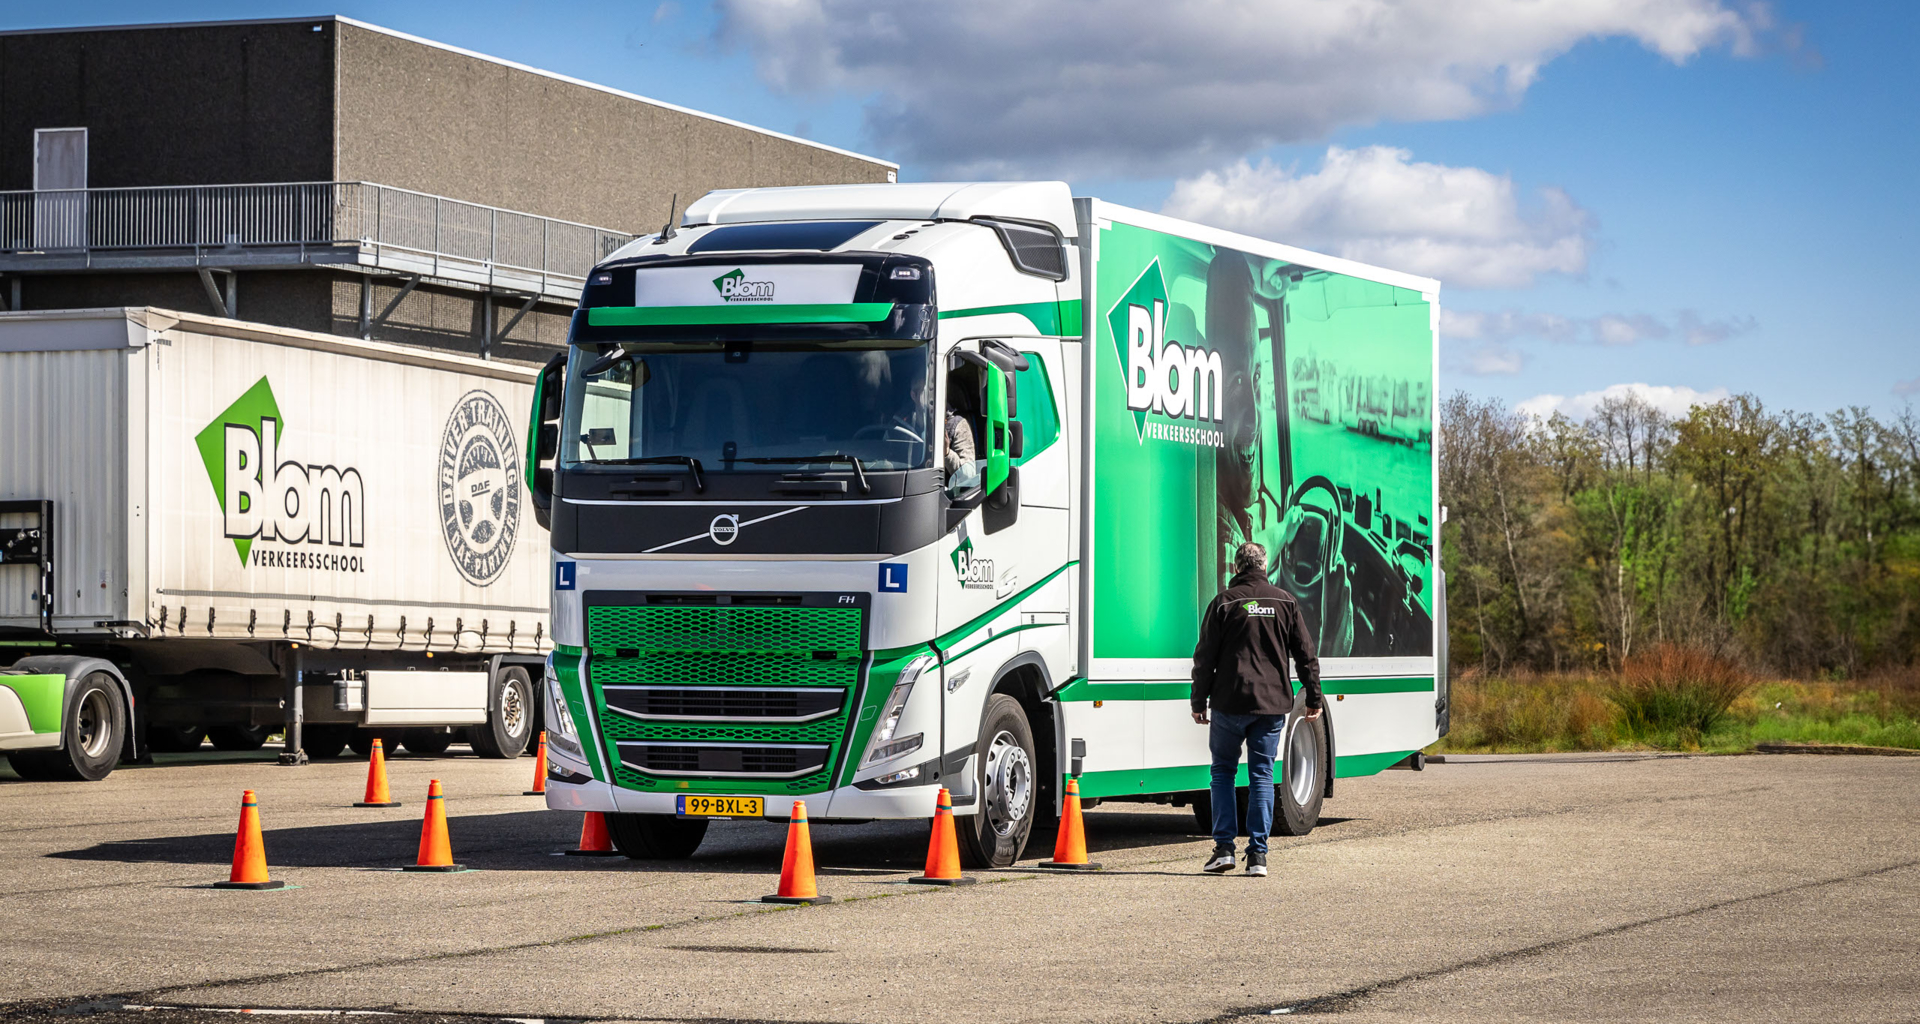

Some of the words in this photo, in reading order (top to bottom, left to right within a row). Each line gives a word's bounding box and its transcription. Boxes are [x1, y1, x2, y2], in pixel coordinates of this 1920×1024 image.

[720, 275, 775, 297] Blom
[1127, 298, 1224, 425] Blom
[1146, 422, 1225, 448] VERKEERSSCHOOL
[443, 412, 469, 506] DRIVER
[469, 400, 518, 486] TRAINING
[224, 415, 364, 548] Blom
[470, 480, 490, 493] DAF
[451, 532, 471, 569] DAF
[475, 516, 515, 577] PARTNER
[252, 550, 365, 573] VERKEERSSCHOOL
[957, 547, 994, 582] Blom
[560, 566, 570, 585] L
[886, 568, 900, 588] L
[838, 595, 855, 604] FH
[1247, 603, 1275, 615] Blom
[691, 798, 757, 814] 99-BXL-3
